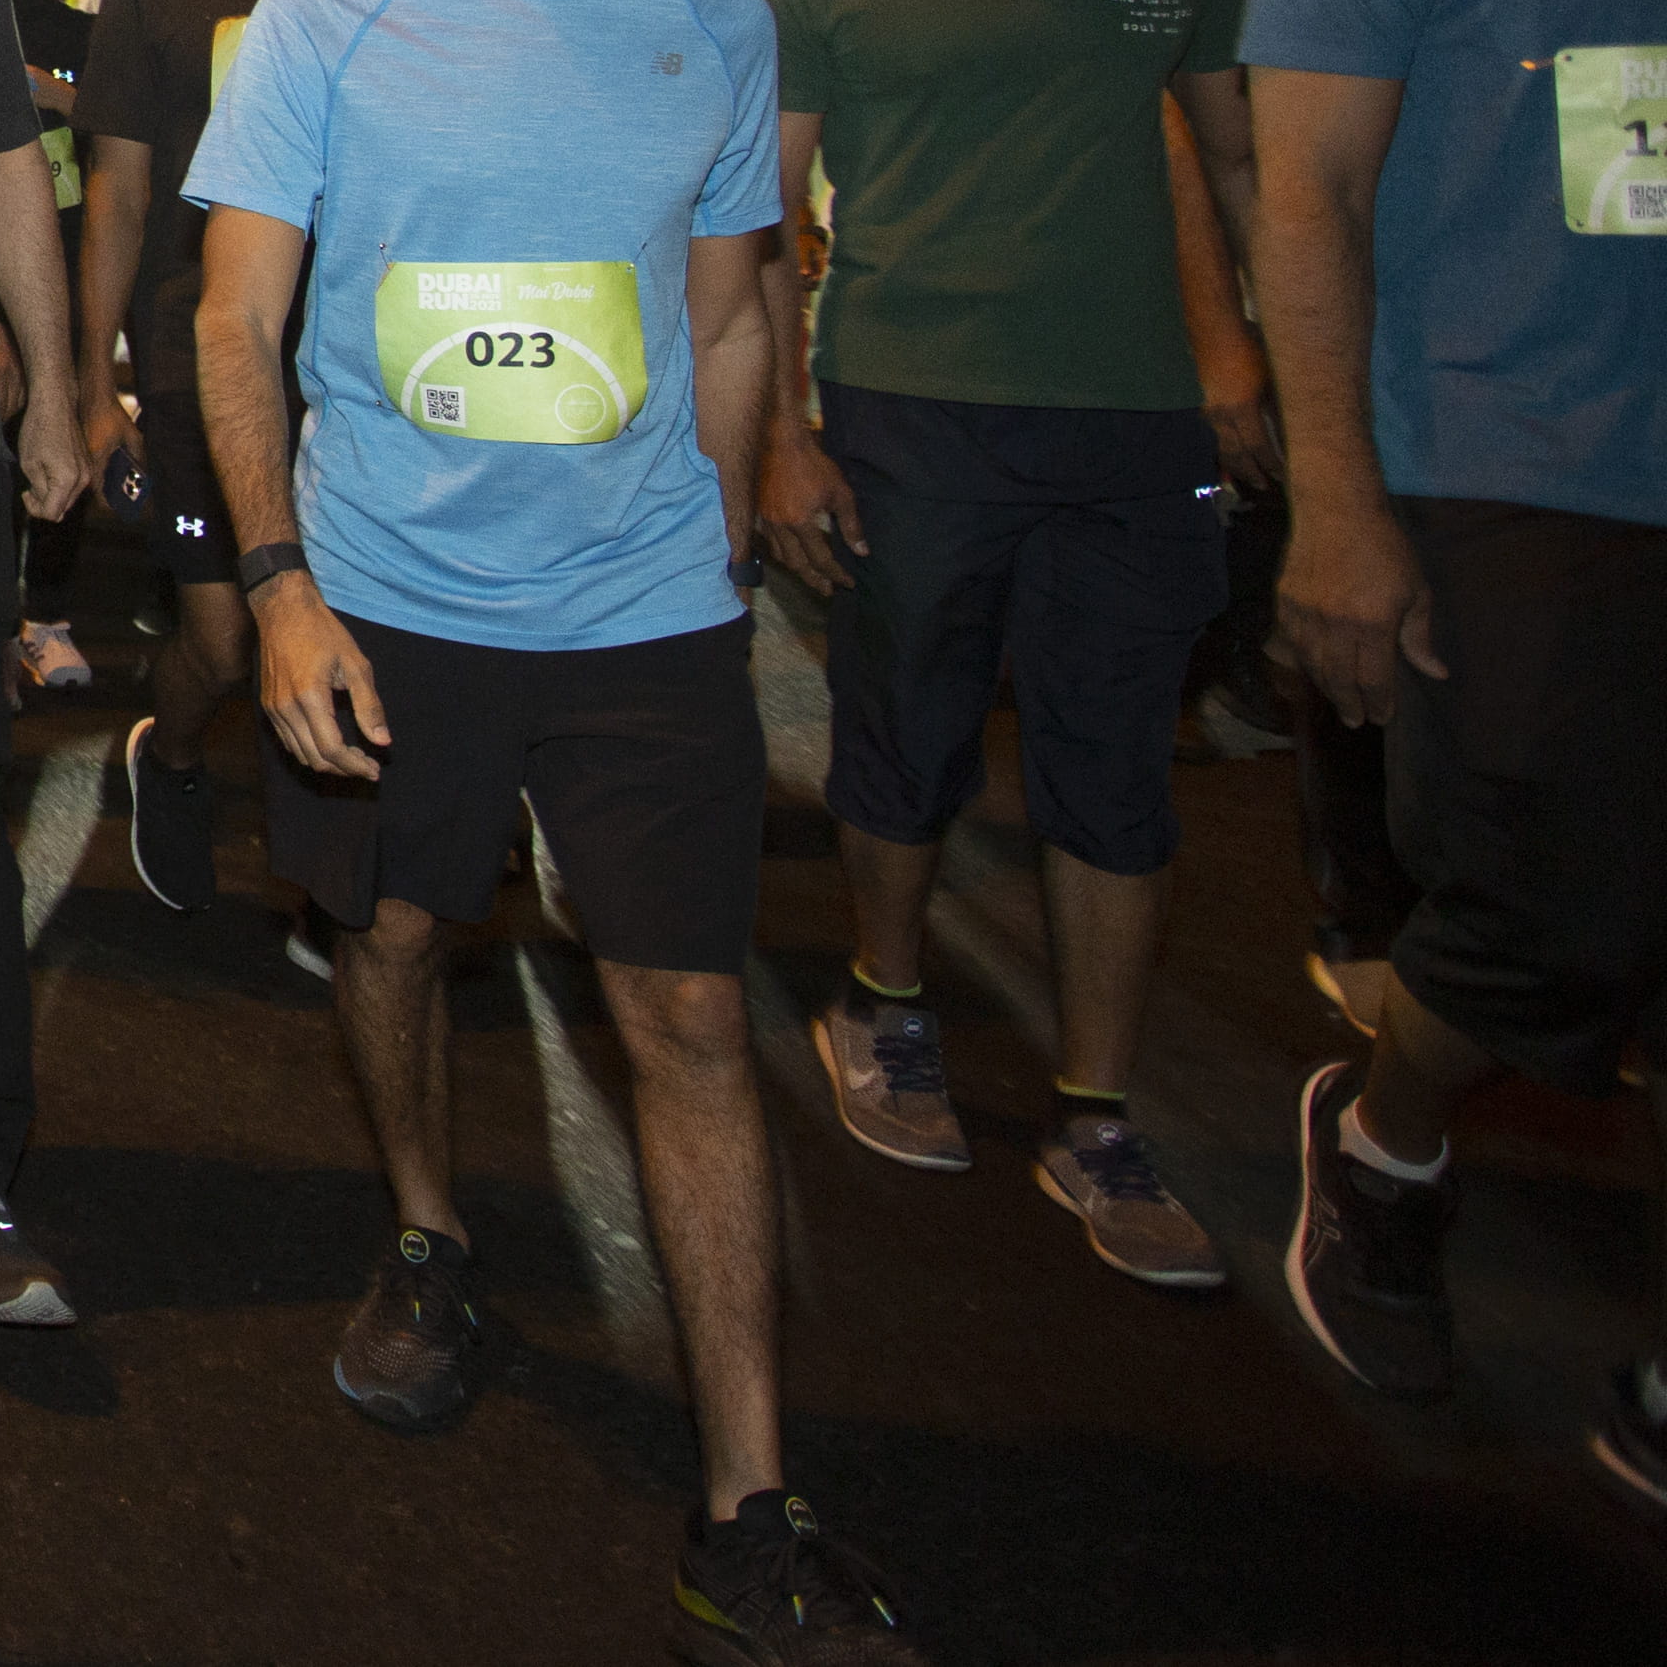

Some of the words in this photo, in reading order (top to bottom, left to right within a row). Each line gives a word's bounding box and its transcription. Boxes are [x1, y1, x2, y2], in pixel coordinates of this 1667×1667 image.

[1623, 120, 1667, 157] 1
[418, 272, 501, 294] DUBAI
[517, 285, 549, 301] Mai
[550, 282, 595, 301] Dubai
[418, 293, 469, 311] RUN
[469, 300, 501, 311] 2021
[465, 330, 556, 369] 023
